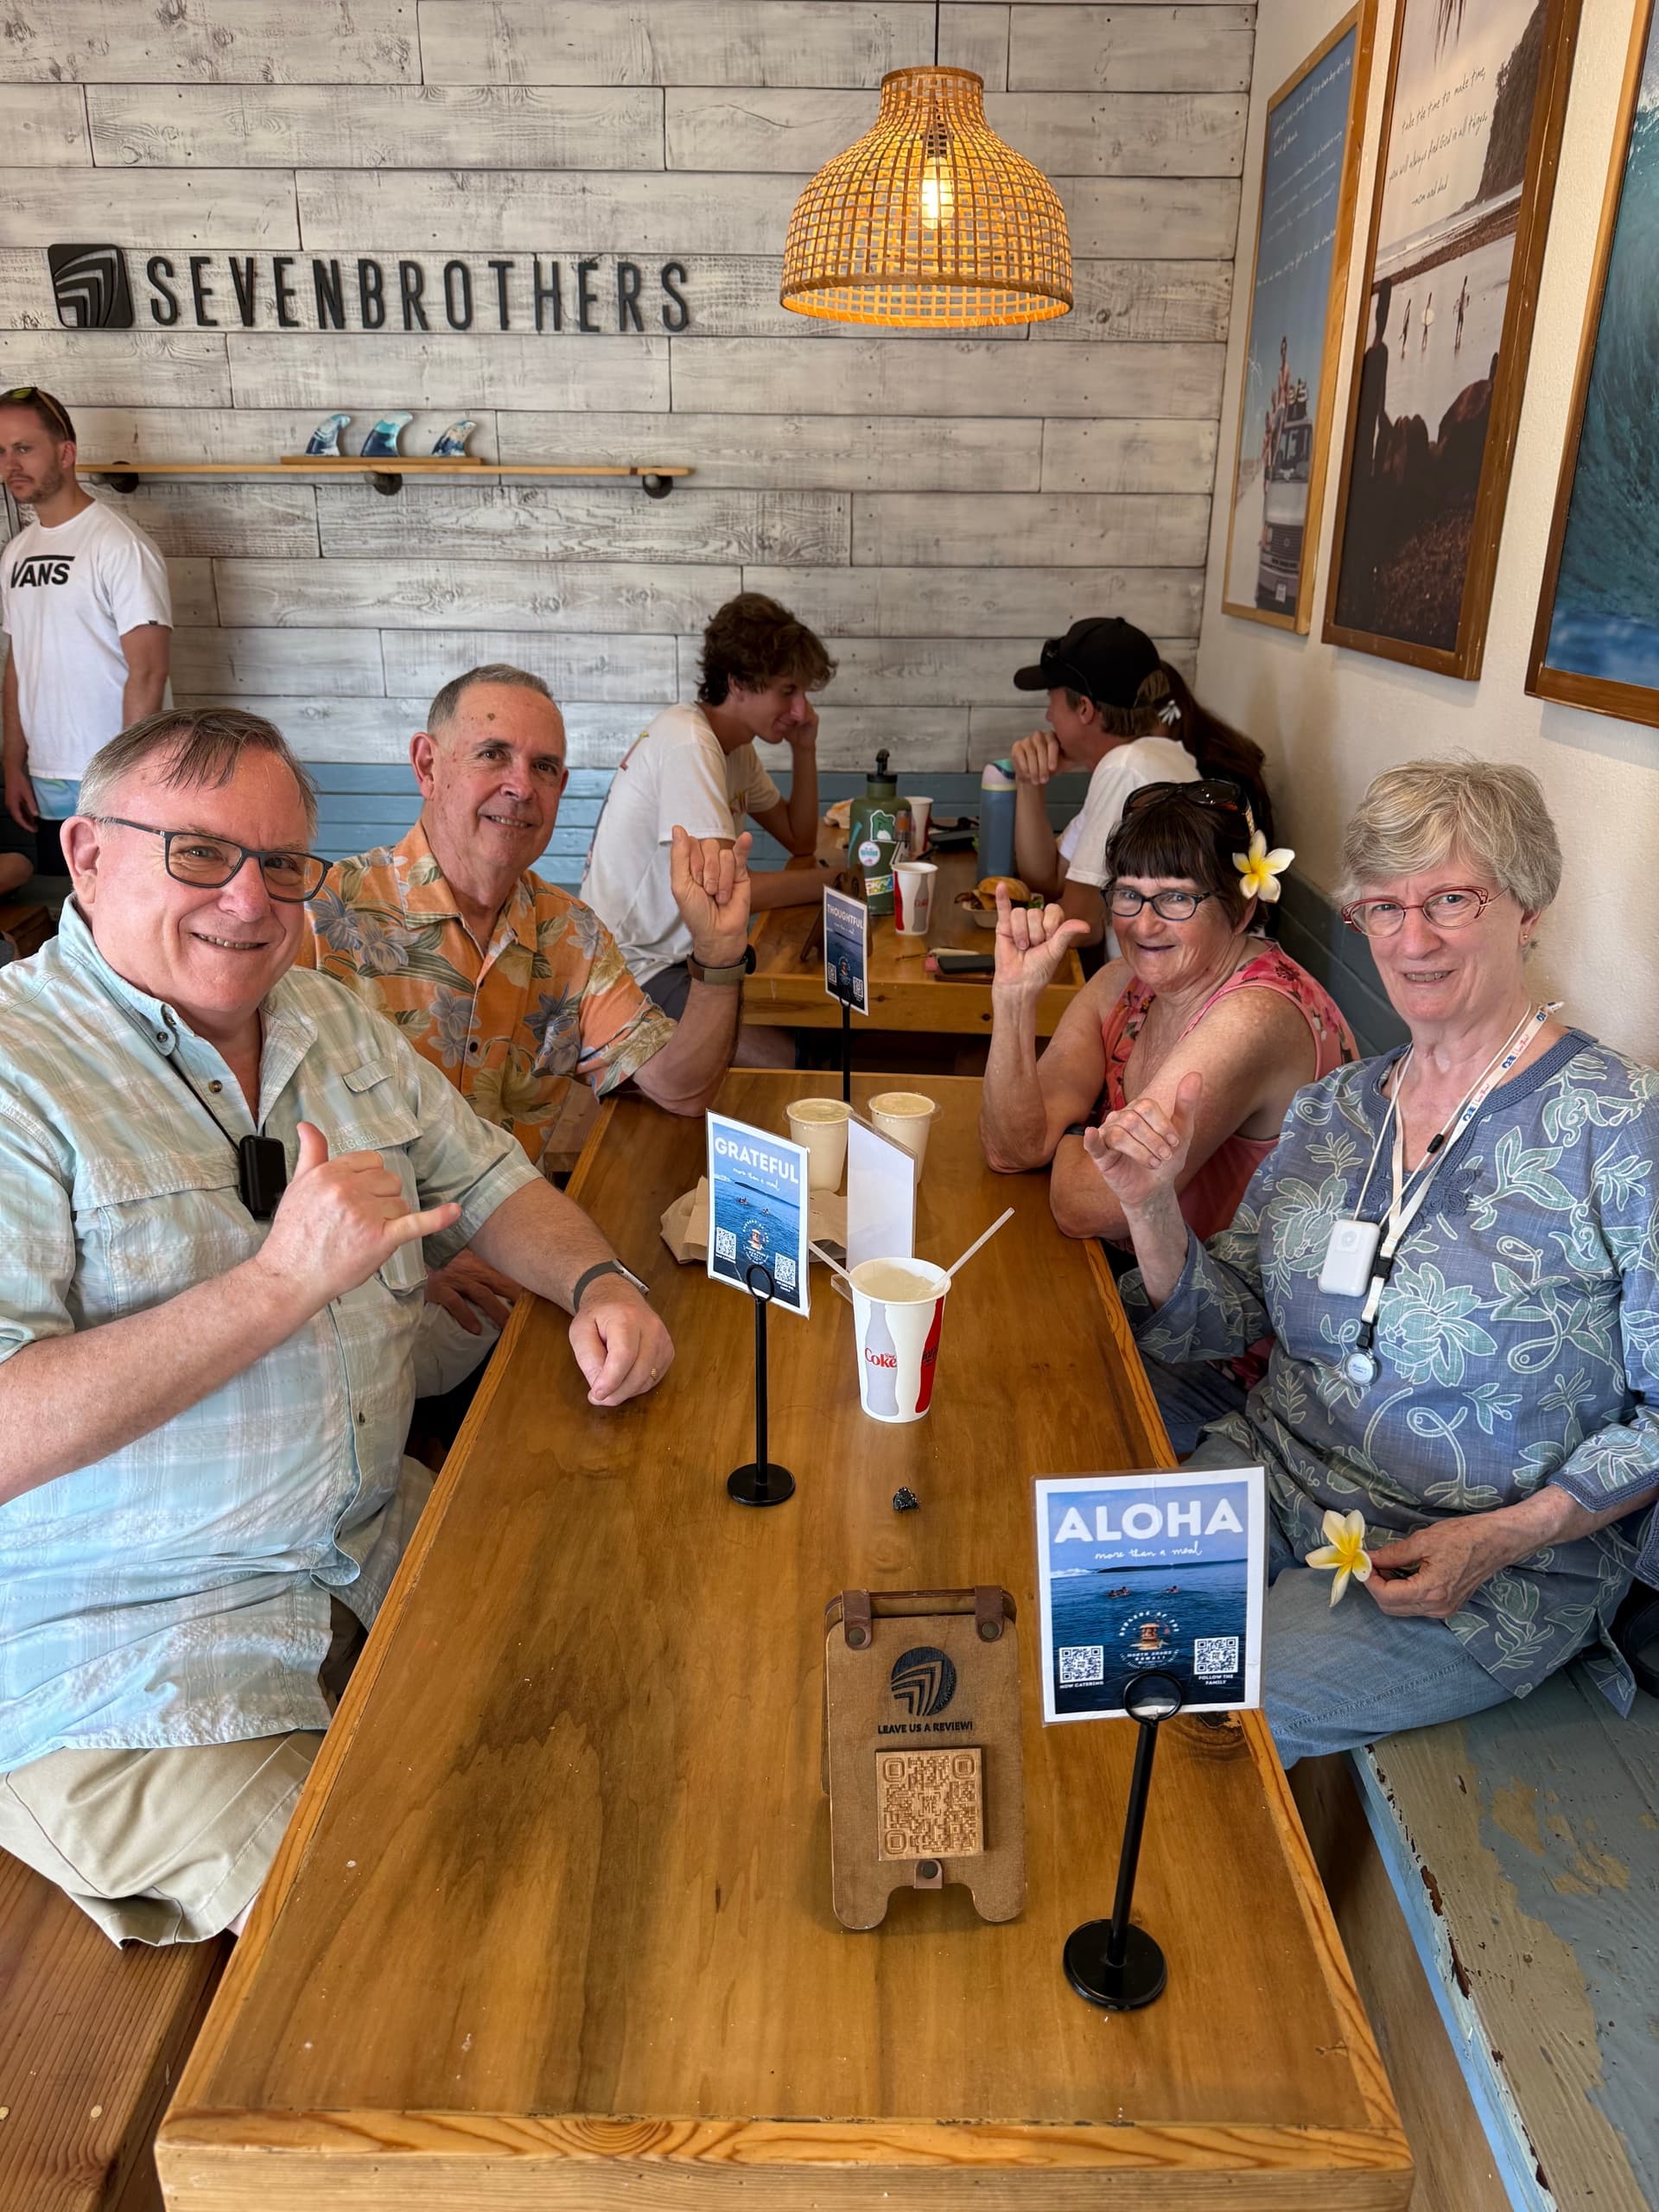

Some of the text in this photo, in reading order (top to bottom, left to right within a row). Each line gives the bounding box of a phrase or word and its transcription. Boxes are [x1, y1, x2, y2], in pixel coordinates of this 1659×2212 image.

[1442, 91, 1452, 108] to
[10, 555, 76, 588] VANS
[827, 903, 864, 930] THOUGHTFUL
[715, 1135, 799, 1185] GRATEFUL
[865, 1347, 897, 1368] Coke
[1054, 1497, 1243, 1544] ALOHA
[1094, 1551, 1125, 1560] more
[1128, 1548, 1156, 1558] than
[1172, 1540, 1203, 1556] meal
[878, 1720, 973, 1735] LEAVE US A REVIEW!
